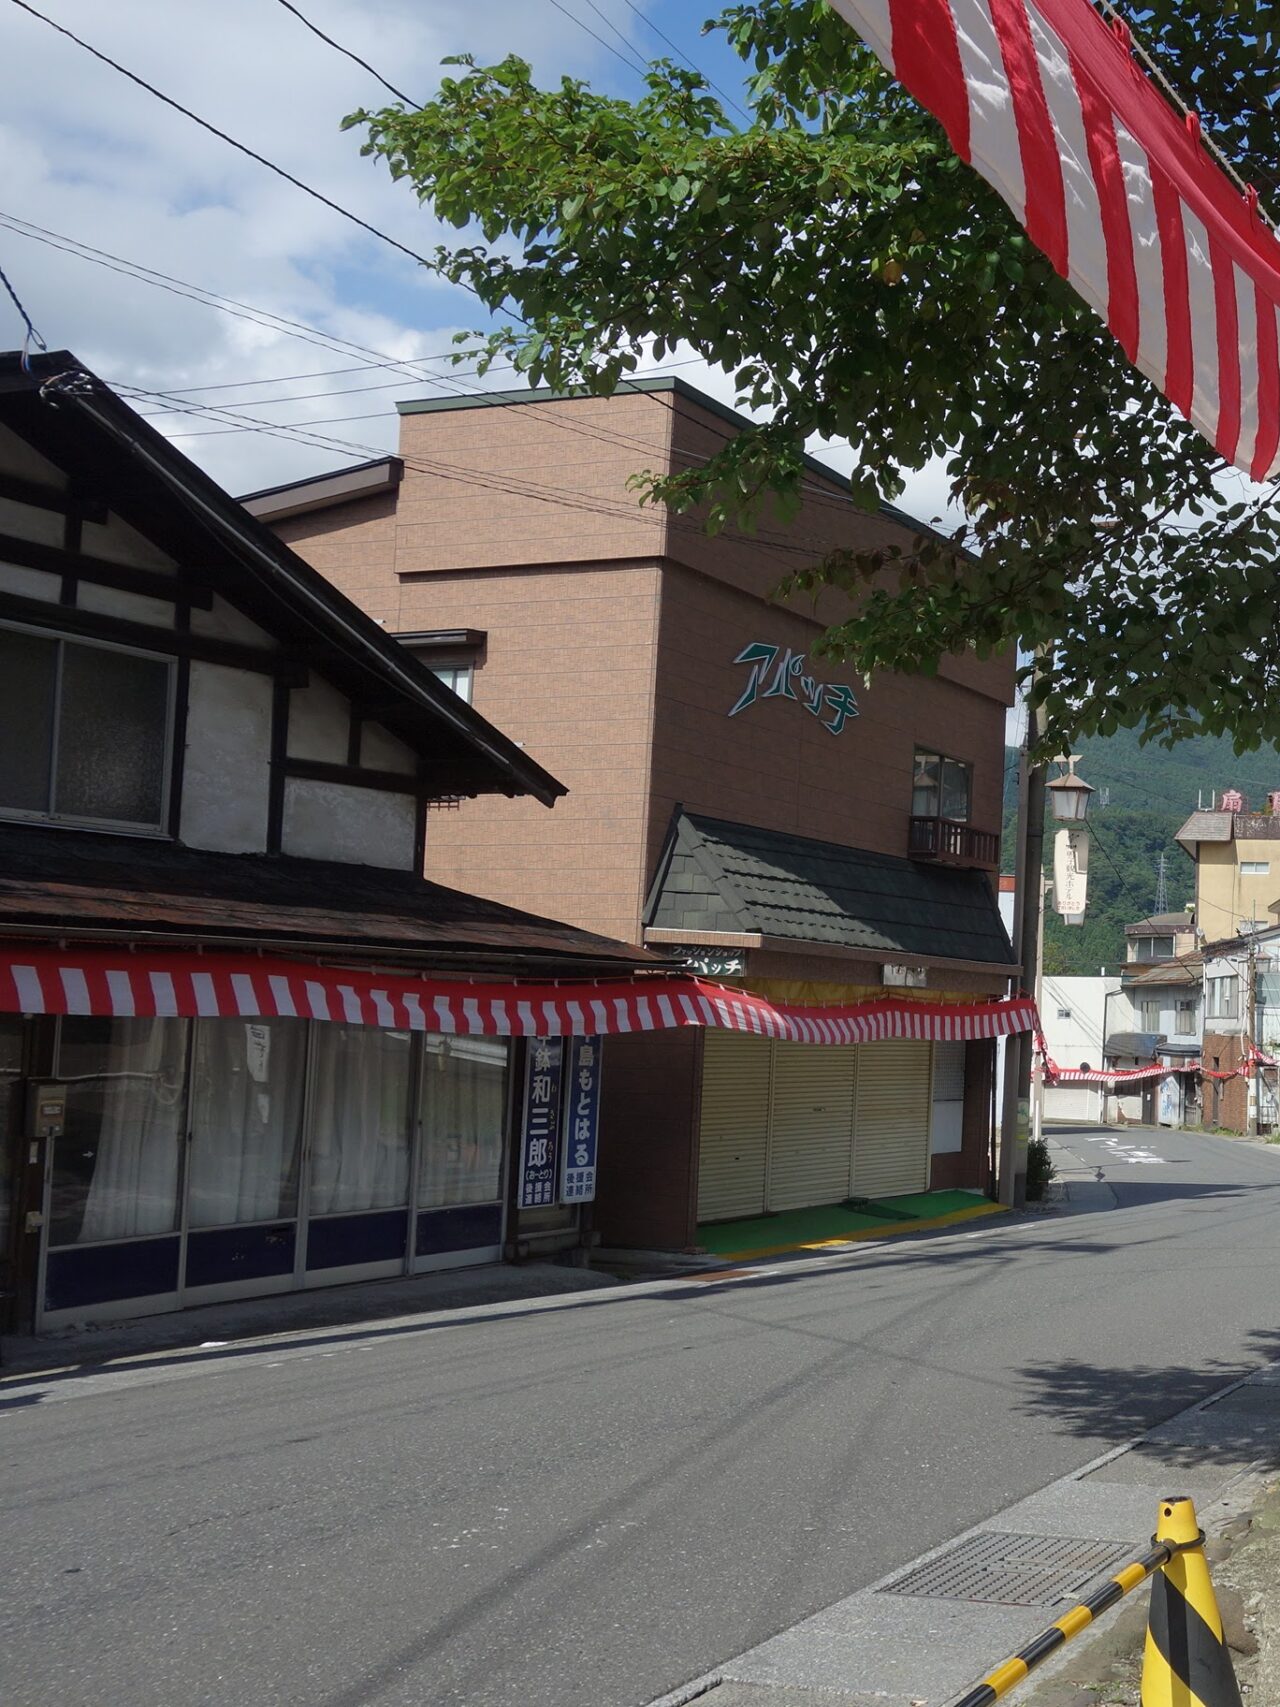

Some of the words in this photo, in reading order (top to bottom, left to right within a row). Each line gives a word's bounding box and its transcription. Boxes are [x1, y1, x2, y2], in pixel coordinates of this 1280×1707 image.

[728, 642, 861, 736] アパッチ
[574, 1036, 594, 1166] 島もとはる
